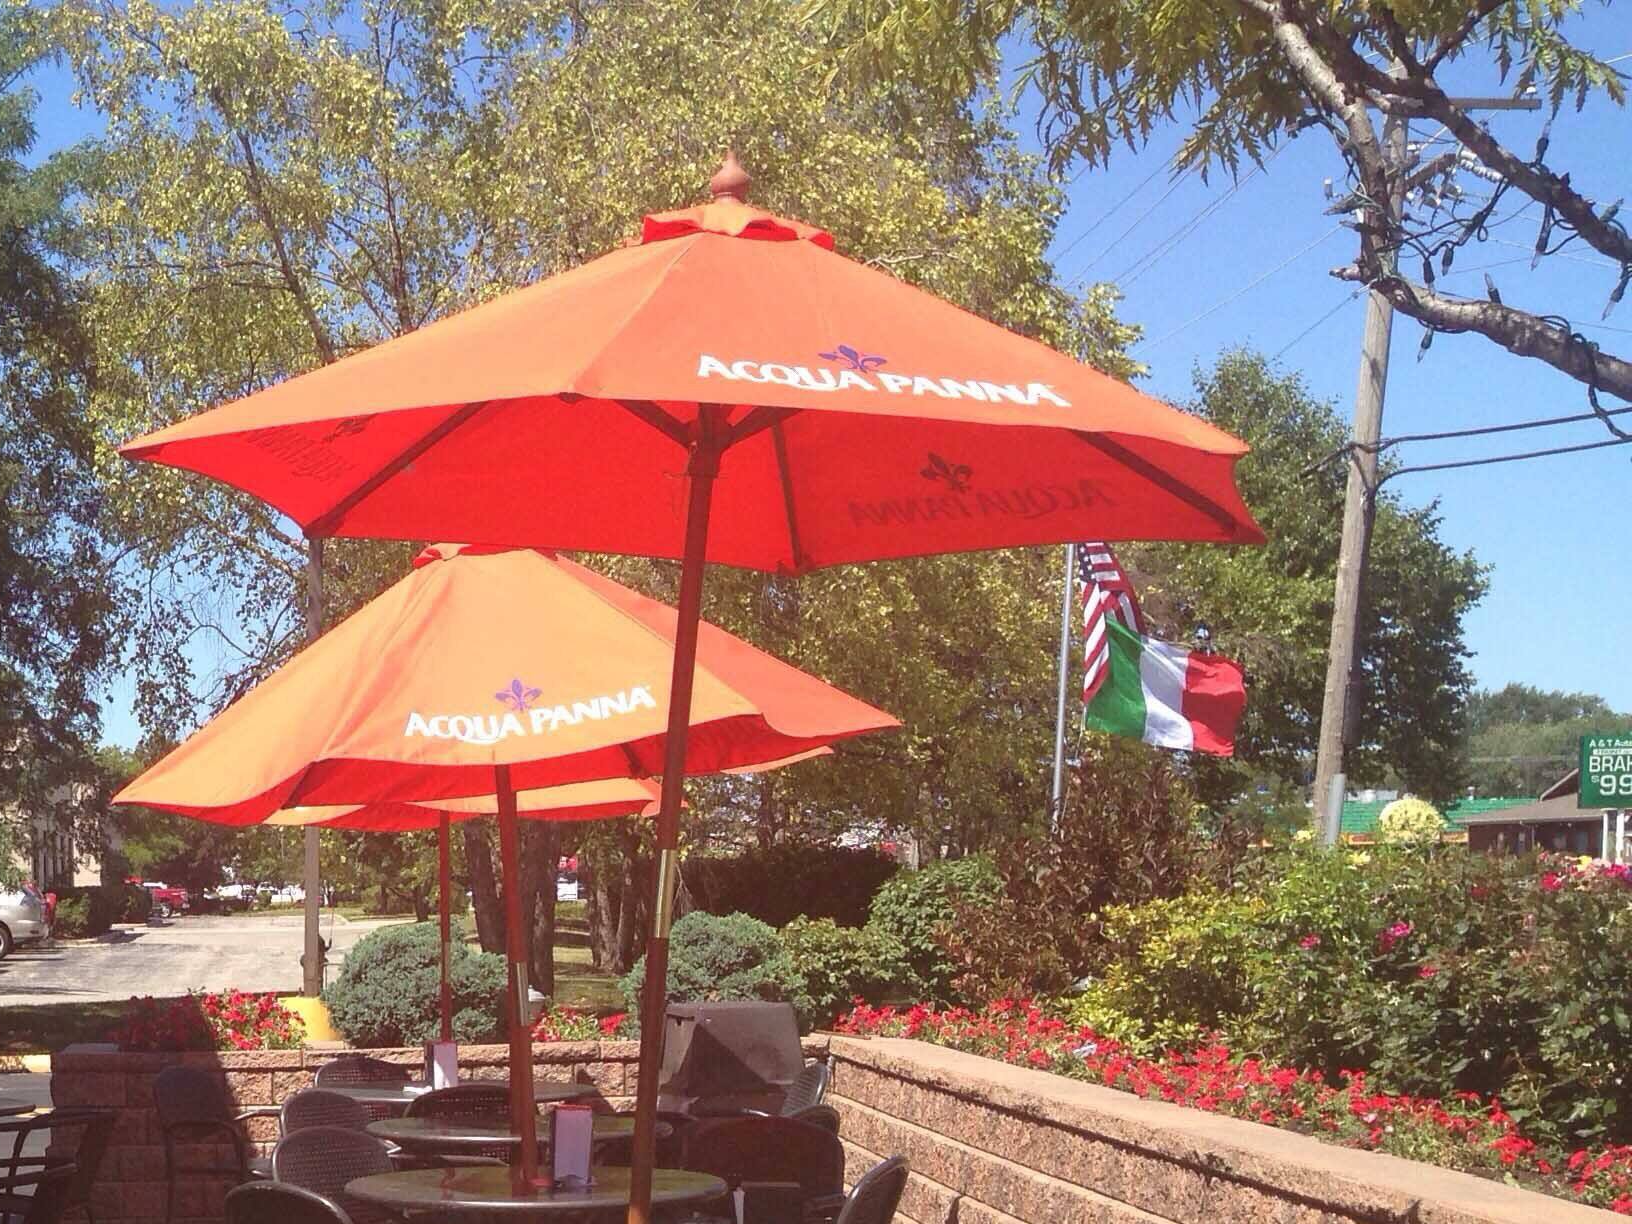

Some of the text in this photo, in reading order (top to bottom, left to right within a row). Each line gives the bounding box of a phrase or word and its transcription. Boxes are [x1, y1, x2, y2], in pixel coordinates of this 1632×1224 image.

[697, 353, 1072, 408] ACQUA PANNA
[404, 686, 657, 745] ACQUA PANNA
